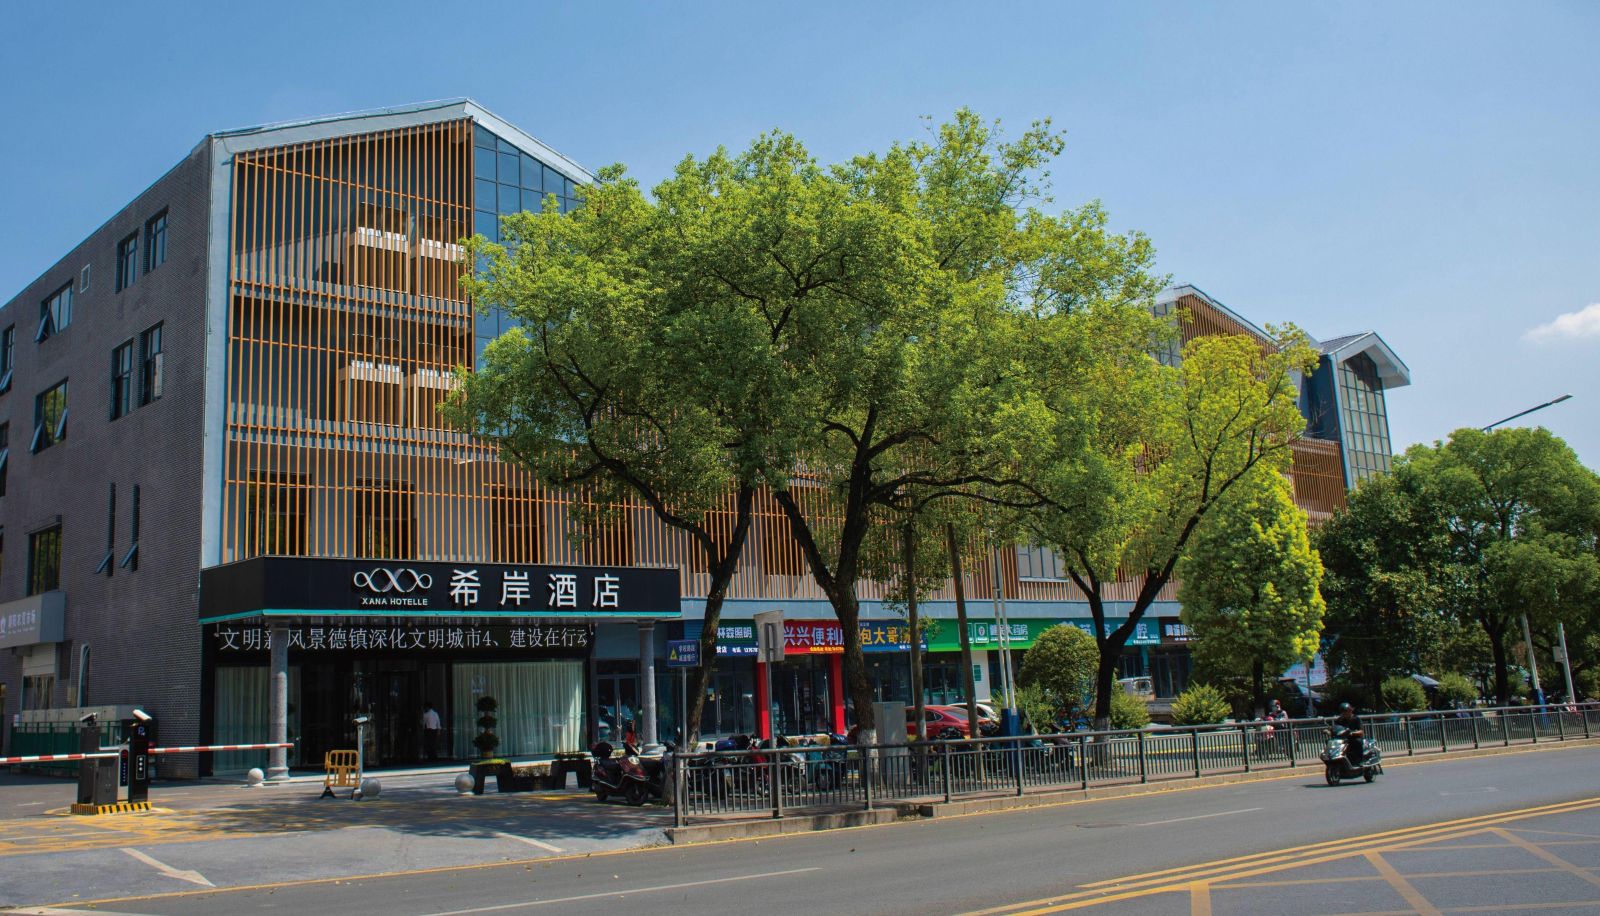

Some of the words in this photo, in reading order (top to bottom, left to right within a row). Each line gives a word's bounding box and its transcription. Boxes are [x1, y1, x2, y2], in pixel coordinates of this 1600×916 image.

[449, 569, 620, 608] 希岸酒店
[362, 597, 388, 606] XANA
[390, 598, 428, 606] HOTELLE
[783, 625, 845, 647] 兴兴便利
